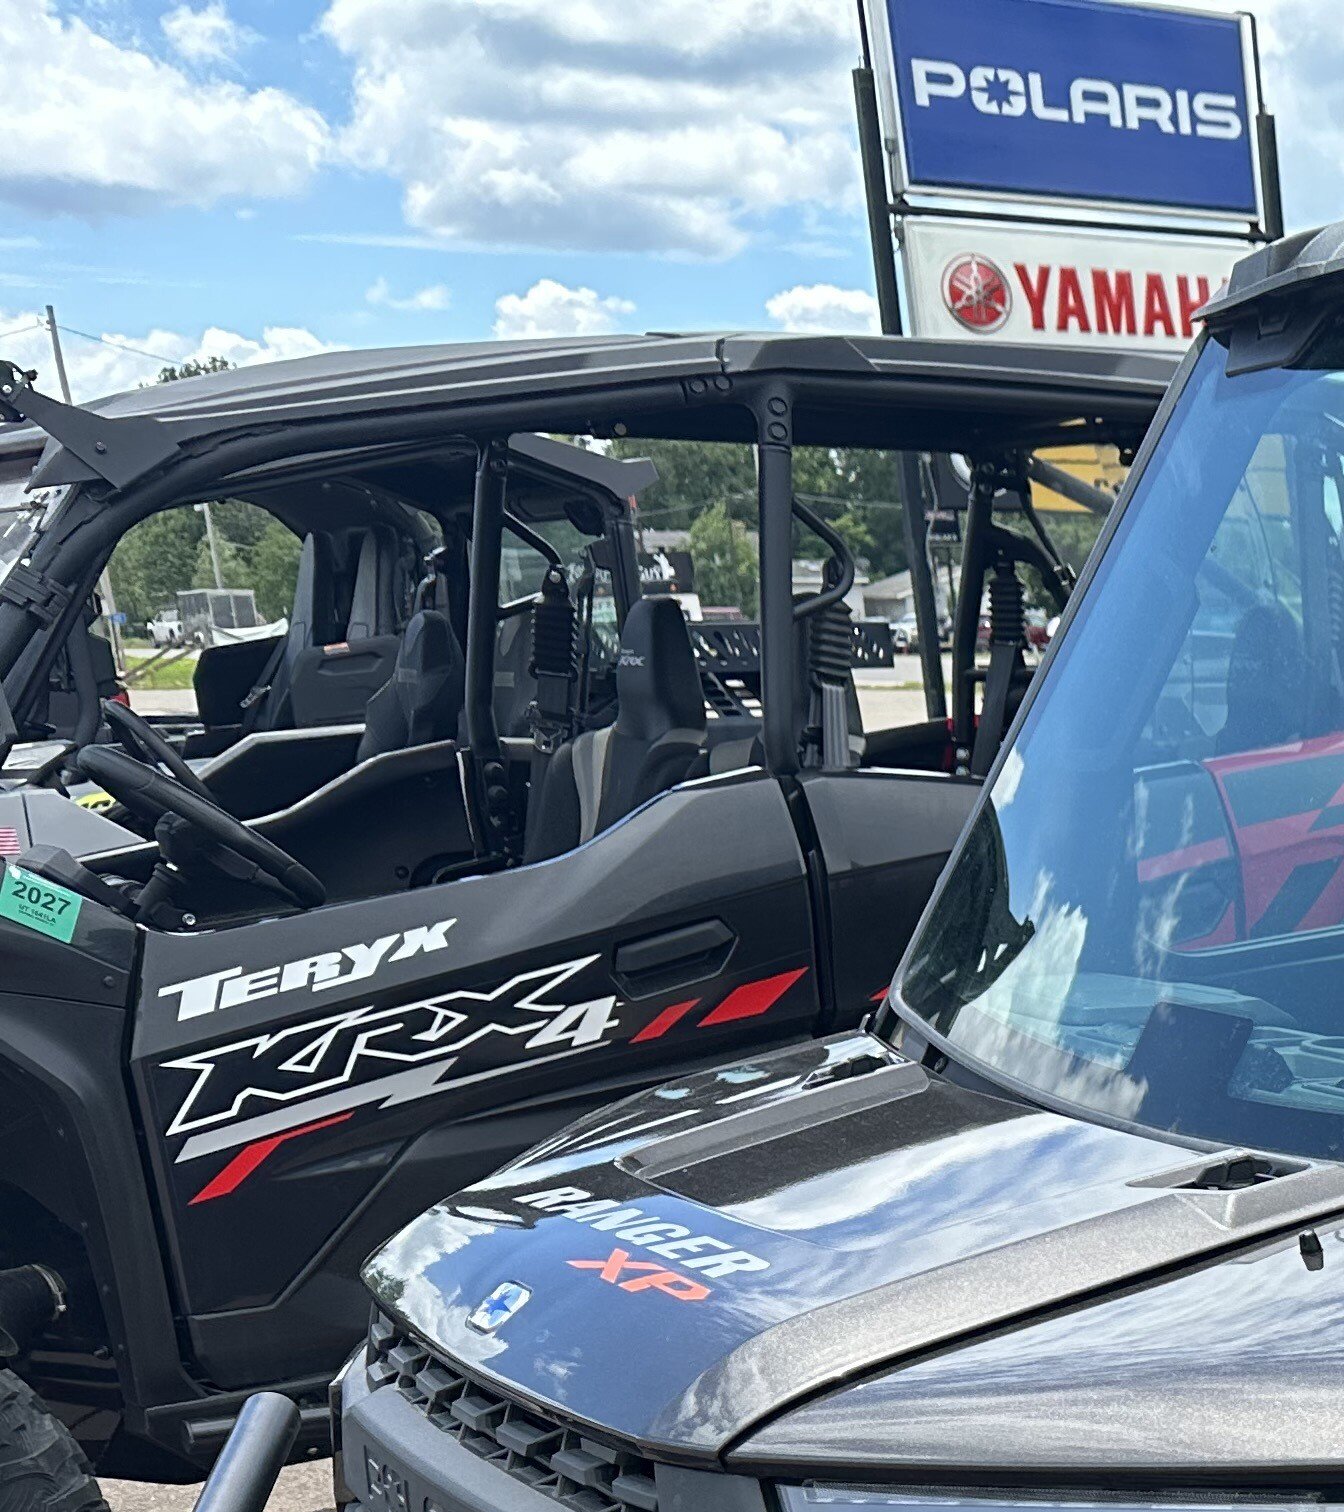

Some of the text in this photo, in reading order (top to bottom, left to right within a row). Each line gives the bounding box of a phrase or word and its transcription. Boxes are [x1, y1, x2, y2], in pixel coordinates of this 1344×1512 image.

[911, 57, 1242, 140] POLARIS
[1014, 261, 1228, 338] YAMAH
[12, 881, 71, 915] 2027
[512, 1186, 771, 1280] RANGER
[566, 1248, 711, 1302] XP
